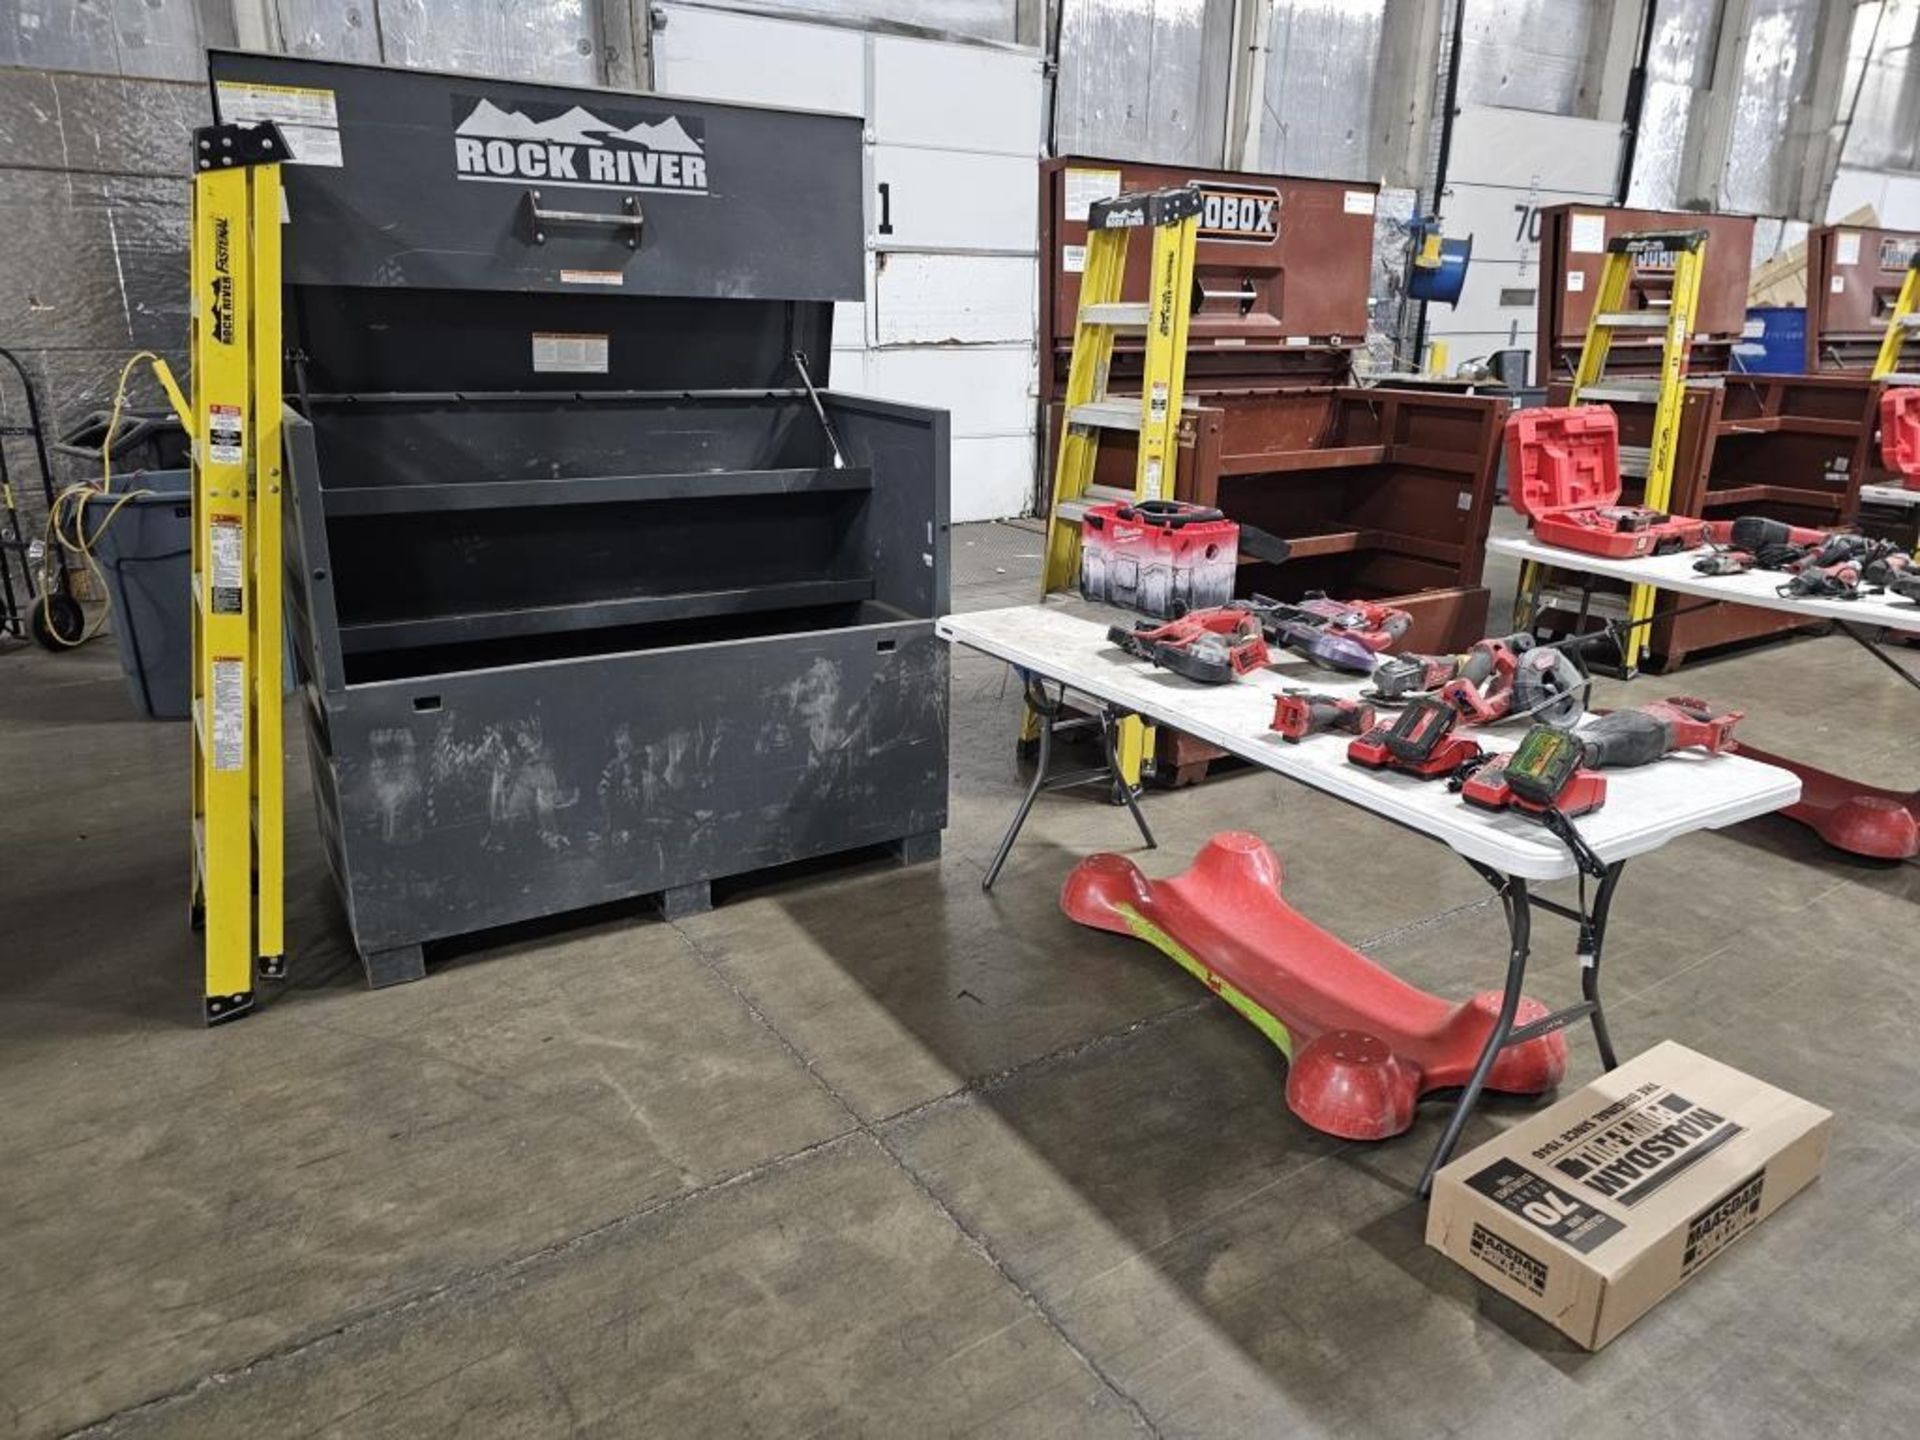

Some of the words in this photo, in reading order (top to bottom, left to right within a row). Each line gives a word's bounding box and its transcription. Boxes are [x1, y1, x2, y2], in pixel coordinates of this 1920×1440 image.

[455, 137, 579, 180] ROCK
[588, 148, 708, 188] RIVER
[878, 183, 893, 234] 1
[1199, 194, 1274, 232] OBOX
[222, 275, 233, 312] RIVER
[222, 313, 233, 344] ROCK
[1557, 1119, 1598, 1143] SINCE
[1580, 1106, 1726, 1198] MAASDAM
[1517, 1188, 1582, 1228] 70
[1685, 1176, 1764, 1249] MAASDAM
[1472, 1226, 1546, 1281] MAASDAM
